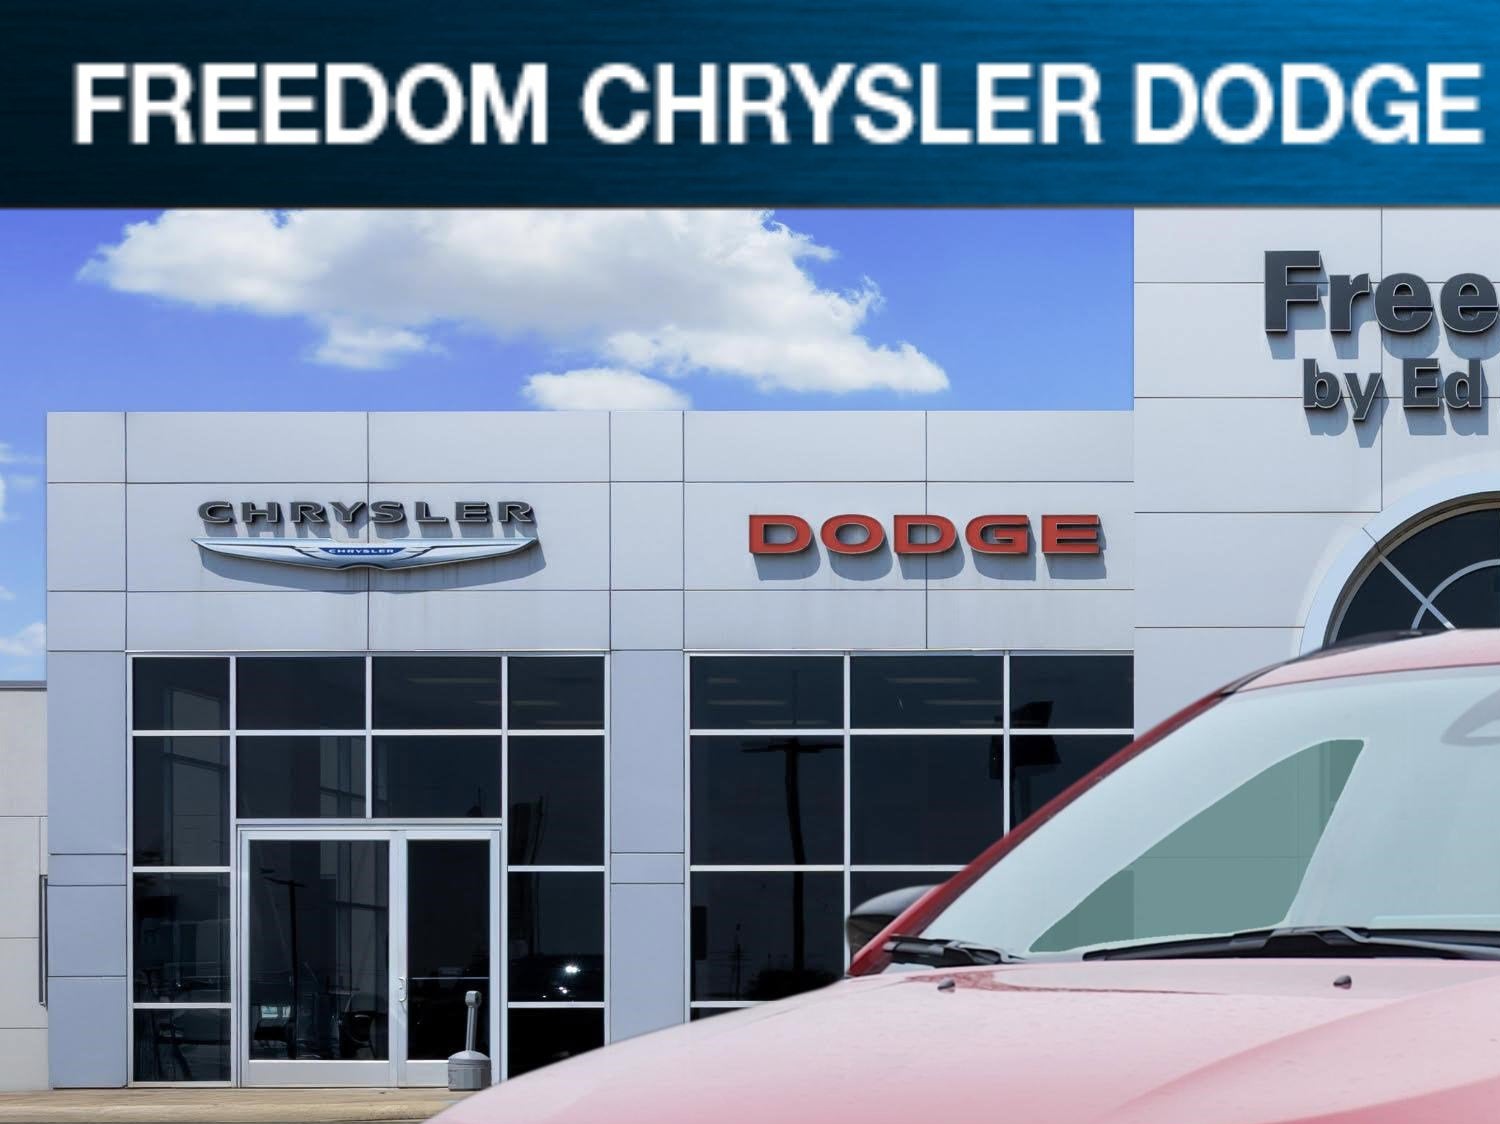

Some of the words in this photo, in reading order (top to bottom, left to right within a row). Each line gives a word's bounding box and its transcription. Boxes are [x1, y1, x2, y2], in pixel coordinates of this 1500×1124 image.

[1303, 358, 1382, 421] by
[1403, 358, 1482, 409] Ed
[198, 500, 535, 525] CHRYSLER
[749, 513, 1102, 556] DODGE
